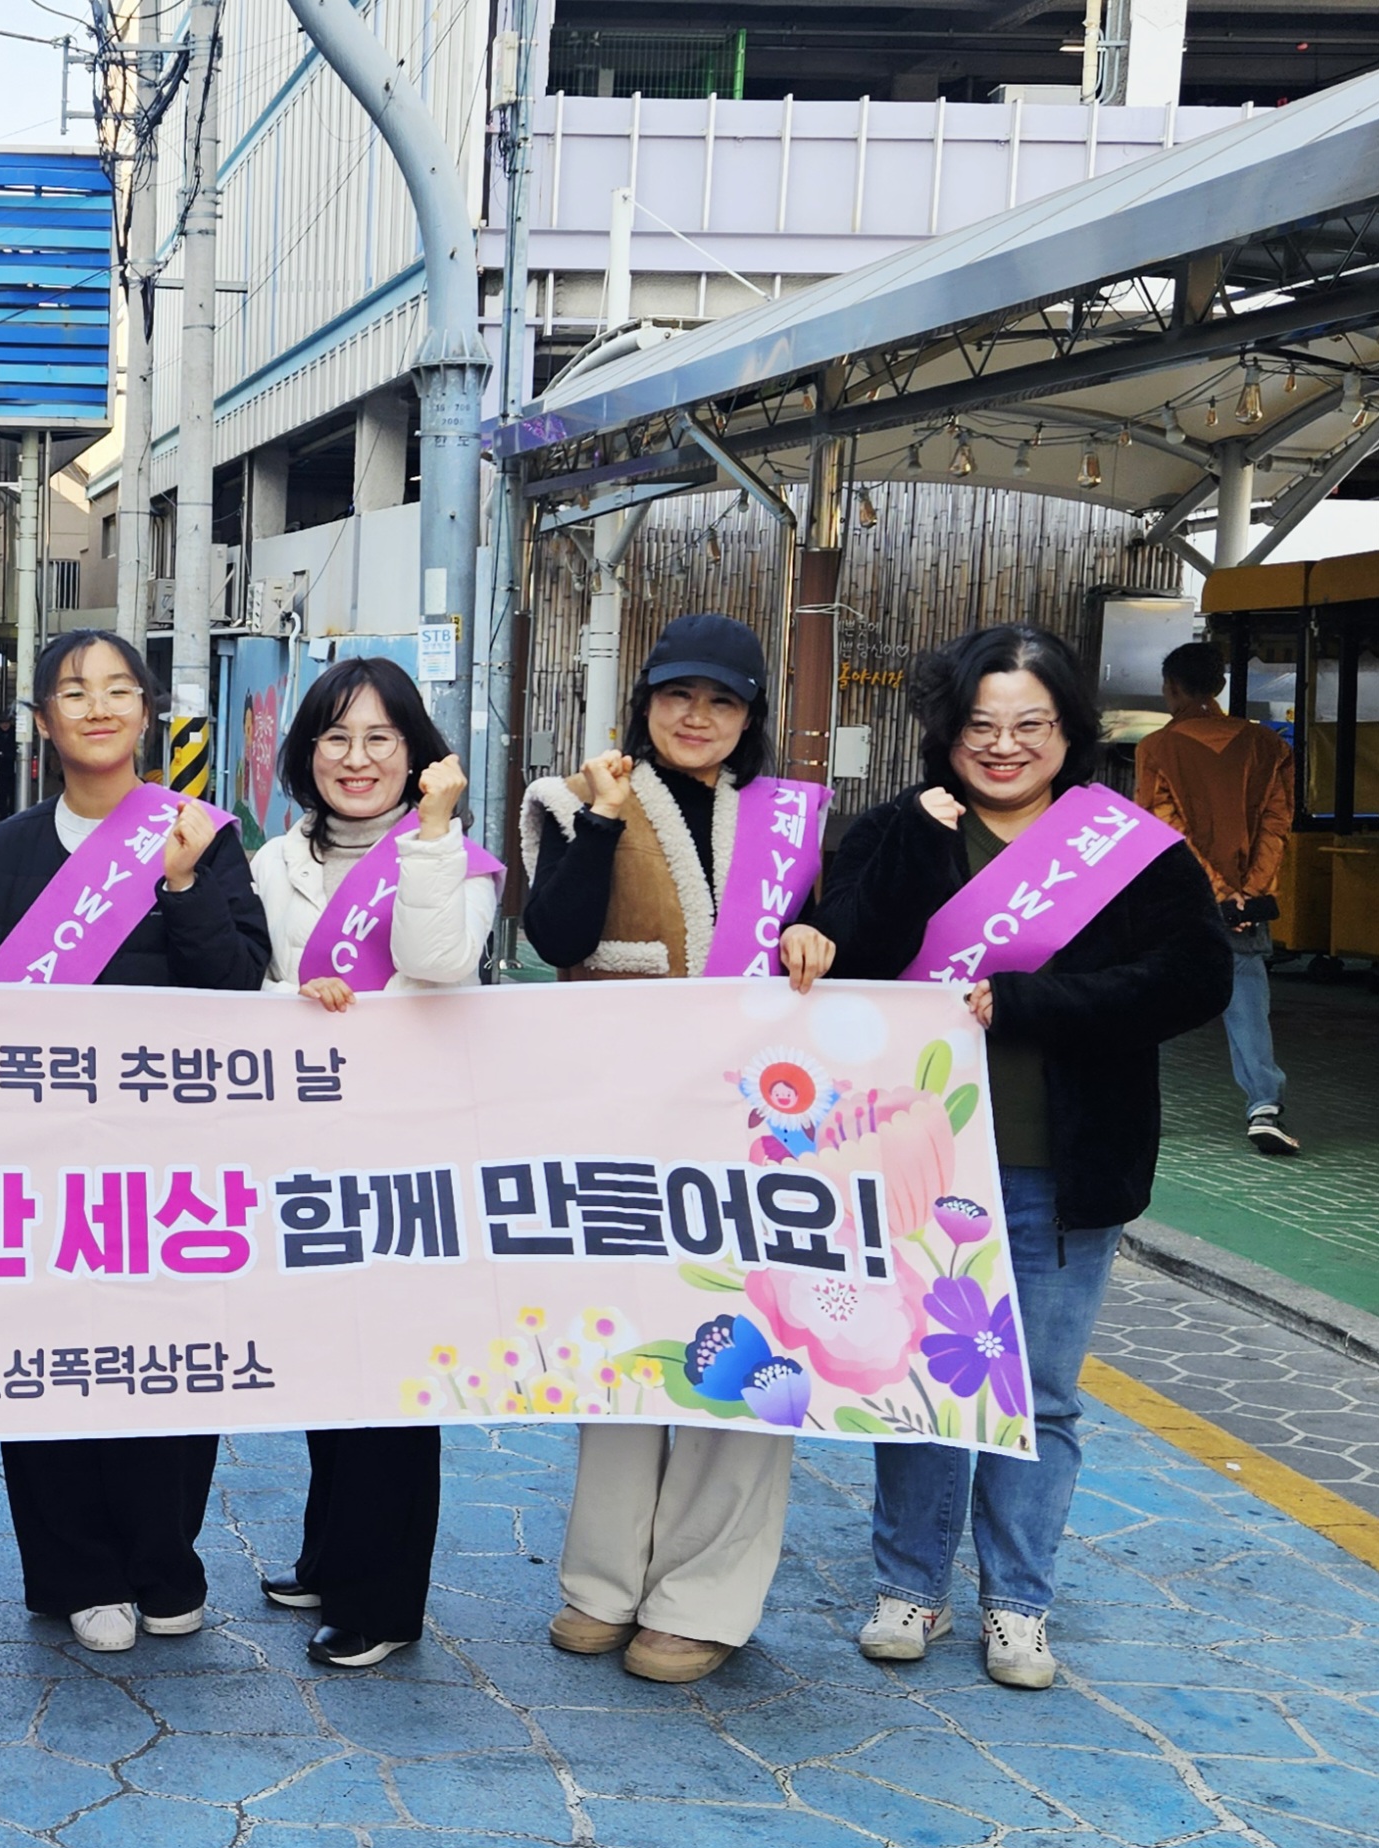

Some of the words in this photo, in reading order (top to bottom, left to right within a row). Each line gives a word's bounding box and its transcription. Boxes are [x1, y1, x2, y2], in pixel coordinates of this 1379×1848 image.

[422, 629, 451, 642] STB
[20, 803, 178, 984] 거제YWCA
[331, 857, 401, 975] YWC
[119, 1045, 275, 1104] 추방의
[296, 1047, 347, 1103] 날
[54, 1171, 258, 1274] 세상
[275, 1169, 461, 1268] 함께
[479, 1160, 888, 1279] 만들어요!
